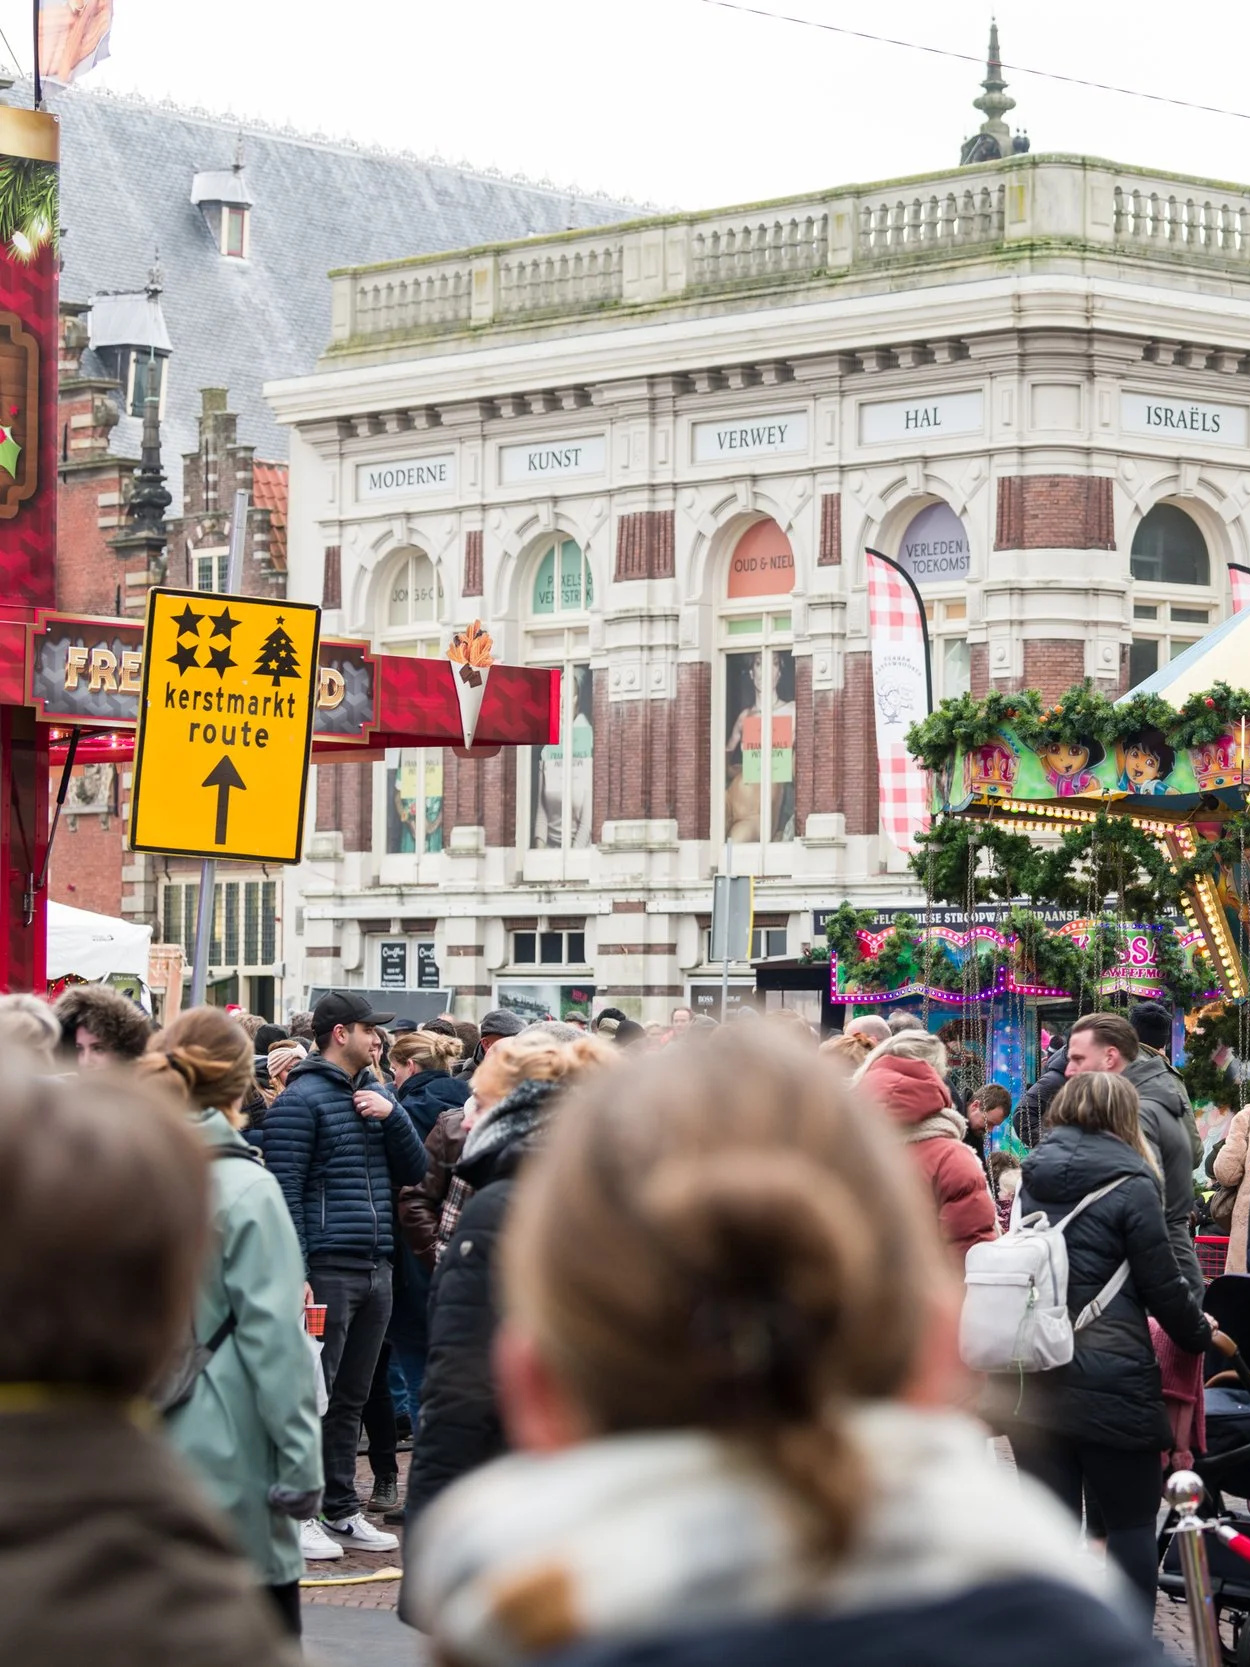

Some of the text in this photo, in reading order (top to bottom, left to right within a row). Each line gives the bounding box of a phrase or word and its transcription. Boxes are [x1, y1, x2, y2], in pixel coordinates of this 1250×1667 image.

[904, 406, 942, 430] HAL
[1145, 404, 1221, 433] ISRAËLS
[716, 424, 789, 450] VERWEY
[527, 448, 582, 472] KUNST
[368, 463, 447, 491] MODERNE
[905, 540, 963, 558] VERLEDEN
[734, 556, 758, 573] OUD
[759, 557, 768, 571] &
[912, 556, 970, 574] TOEKOMST
[547, 572, 582, 588] PXELS
[165, 681, 296, 719] kerstmarkt
[189, 720, 269, 748] route
